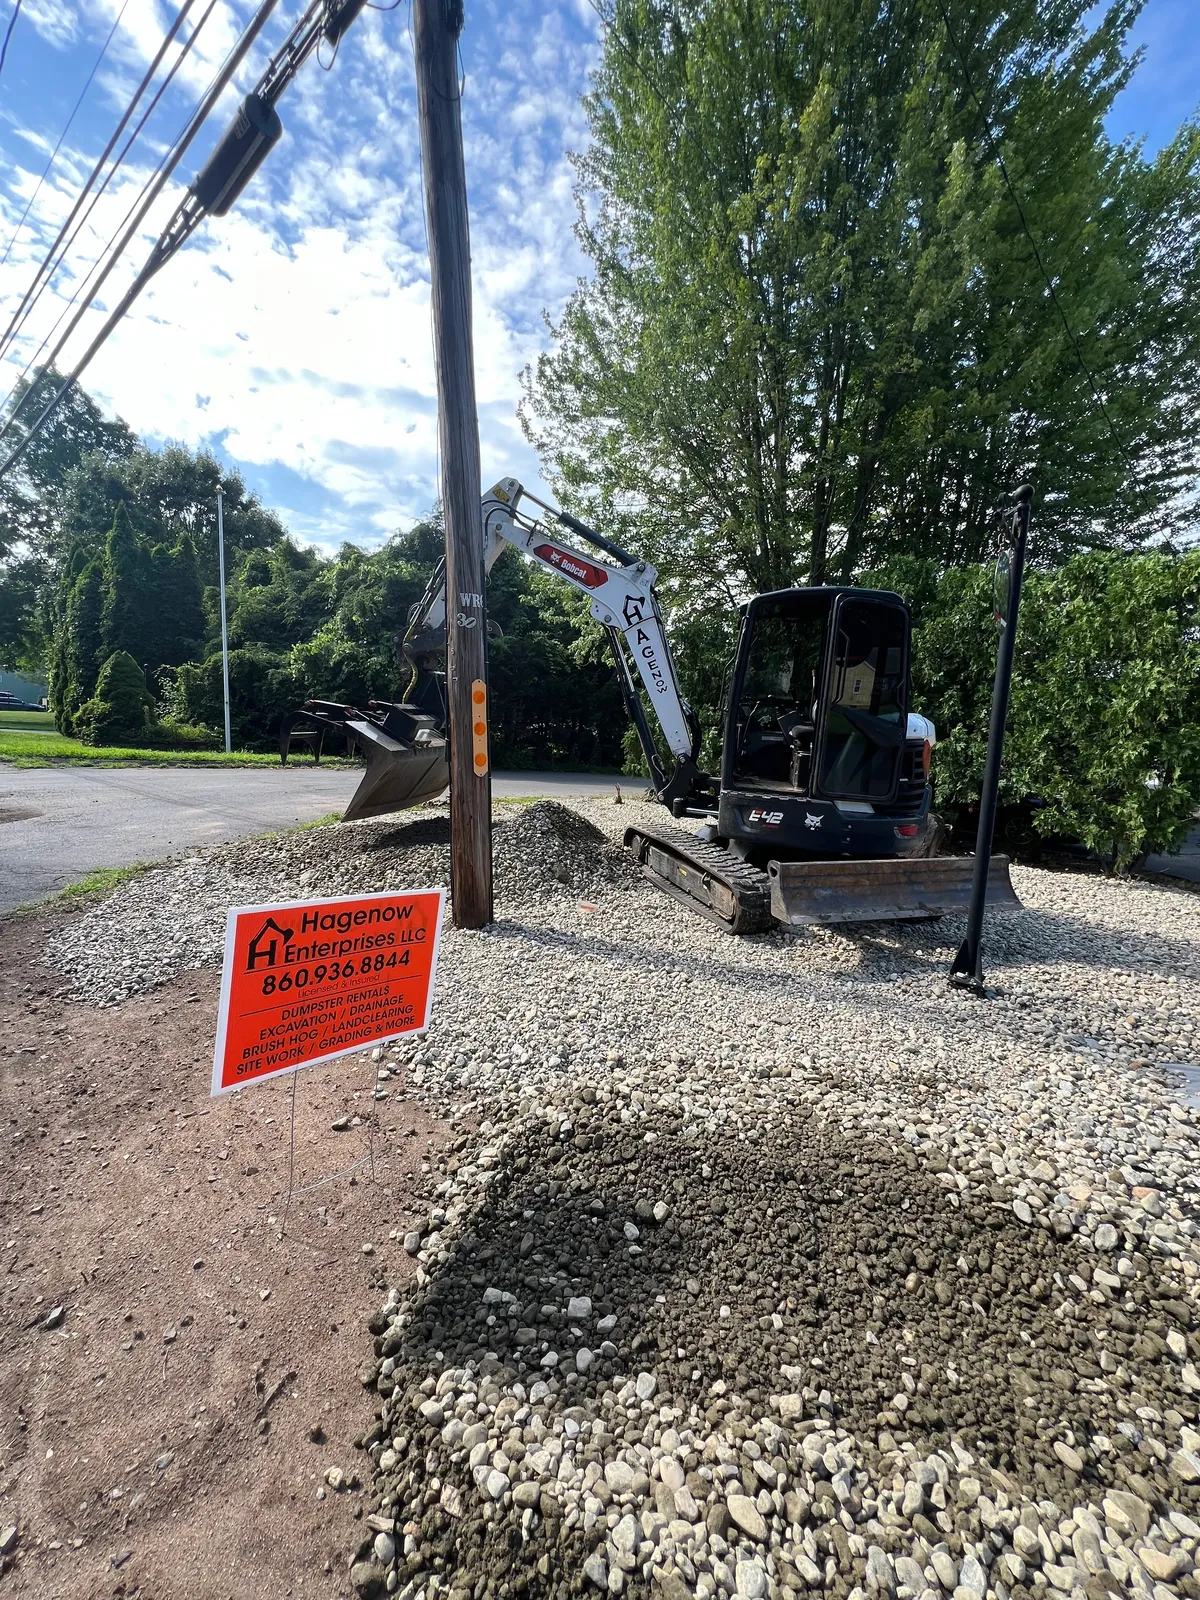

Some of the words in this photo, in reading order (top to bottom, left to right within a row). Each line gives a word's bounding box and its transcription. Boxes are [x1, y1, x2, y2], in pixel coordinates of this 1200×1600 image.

[560, 558, 587, 579] Bobcat
[748, 810, 784, 824] E42
[302, 904, 414, 934] Hagenow
[284, 932, 395, 962] Enterprises
[401, 928, 426, 943] LLC
[262, 949, 410, 996] 860.936.8844
[297, 982, 339, 999] Licensed
[341, 981, 348, 989] &
[350, 974, 381, 987] Insured
[259, 1011, 336, 1041] EXCAVATION
[340, 1007, 346, 1019] /
[350, 994, 404, 1016] DRAINAGE
[281, 996, 343, 1021] DUMPSTER
[346, 985, 390, 1005] RENTALS
[236, 1060, 262, 1076] SITE
[266, 1045, 305, 1065] WORK
[308, 1043, 315, 1054] /
[318, 1026, 372, 1050] GRADING
[375, 1024, 382, 1033] &
[385, 1015, 415, 1031] MORE
[242, 1038, 285, 1060] BRUSH
[289, 1028, 318, 1045] HOG
[322, 1025, 328, 1037] /
[332, 1004, 413, 1034] LANDCLEARING
